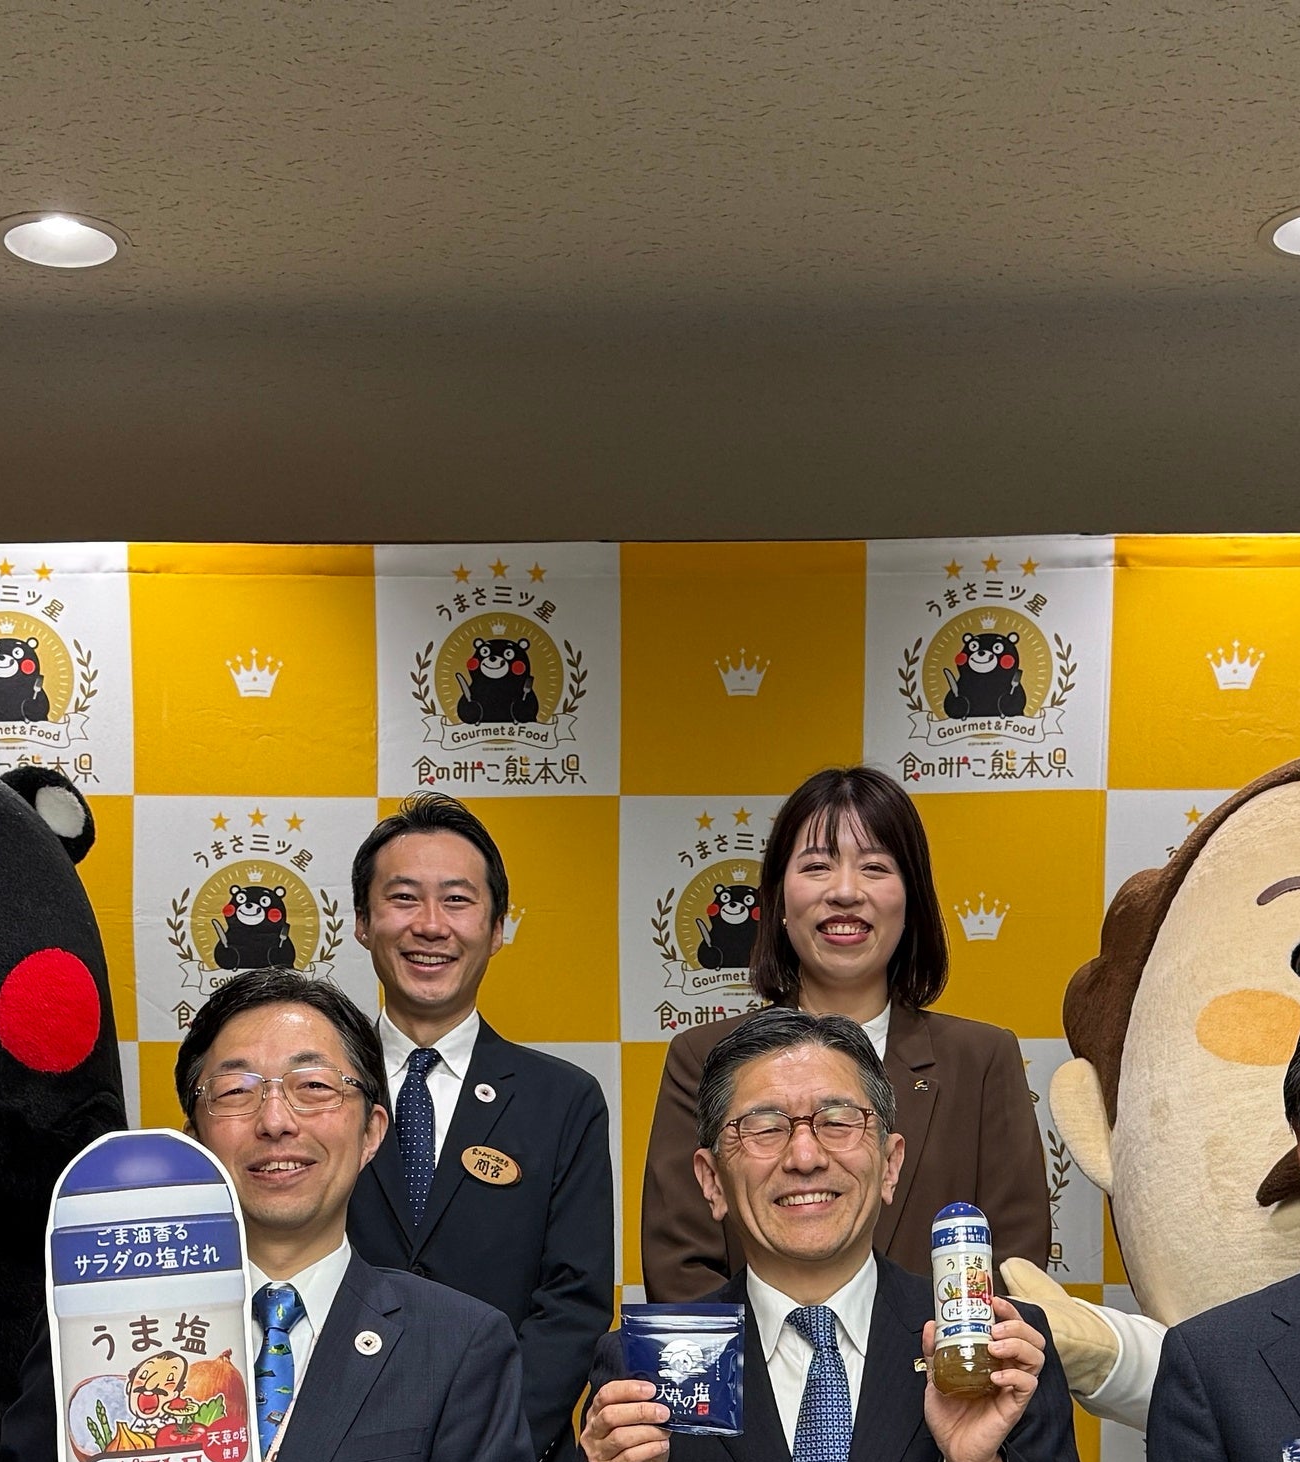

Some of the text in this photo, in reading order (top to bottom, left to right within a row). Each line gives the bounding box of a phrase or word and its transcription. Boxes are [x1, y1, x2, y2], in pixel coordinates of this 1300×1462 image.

[436, 586, 557, 624] うまさ三ツ星
[926, 581, 1048, 617] うまさ三ツ星
[19, 725, 27, 736] &
[29, 725, 60, 741] Food
[451, 726, 549, 744] Gourmet & Food
[937, 720, 1036, 739] Gourmet & Food
[412, 754, 587, 786] 食のみやこ熊本県
[897, 747, 1074, 782] 食のみやこ熊本県
[193, 834, 313, 872] うまさ三ツ星
[692, 971, 746, 988] Gourmet
[97, 1223, 189, 1247] ごま油香る
[75, 1243, 220, 1277] サラダの塩だれ
[92, 1312, 211, 1361] うま塩
[656, 1382, 711, 1409] 天草の塩
